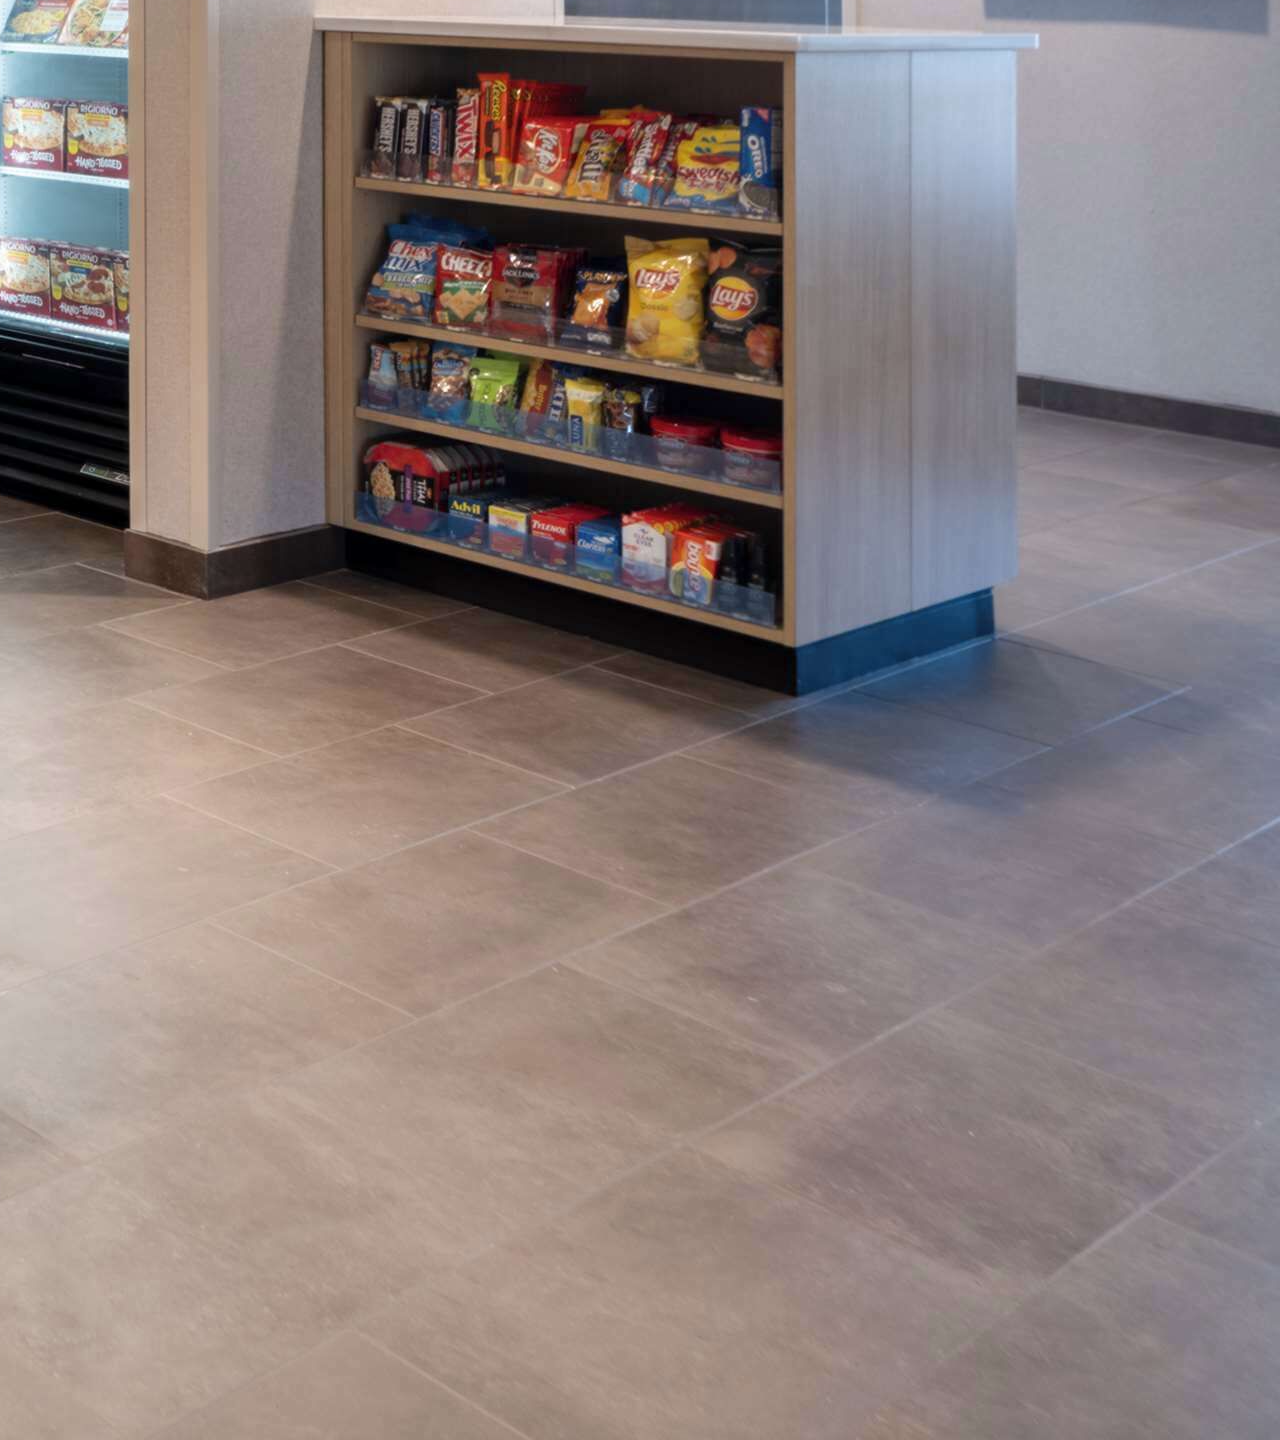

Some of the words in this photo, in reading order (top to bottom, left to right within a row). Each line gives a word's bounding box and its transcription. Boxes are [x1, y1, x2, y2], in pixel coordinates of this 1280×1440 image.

[455, 97, 478, 160] TWIX
[748, 135, 763, 178] OREO
[713, 285, 754, 311] Lay's
[450, 500, 481, 515] Advil
